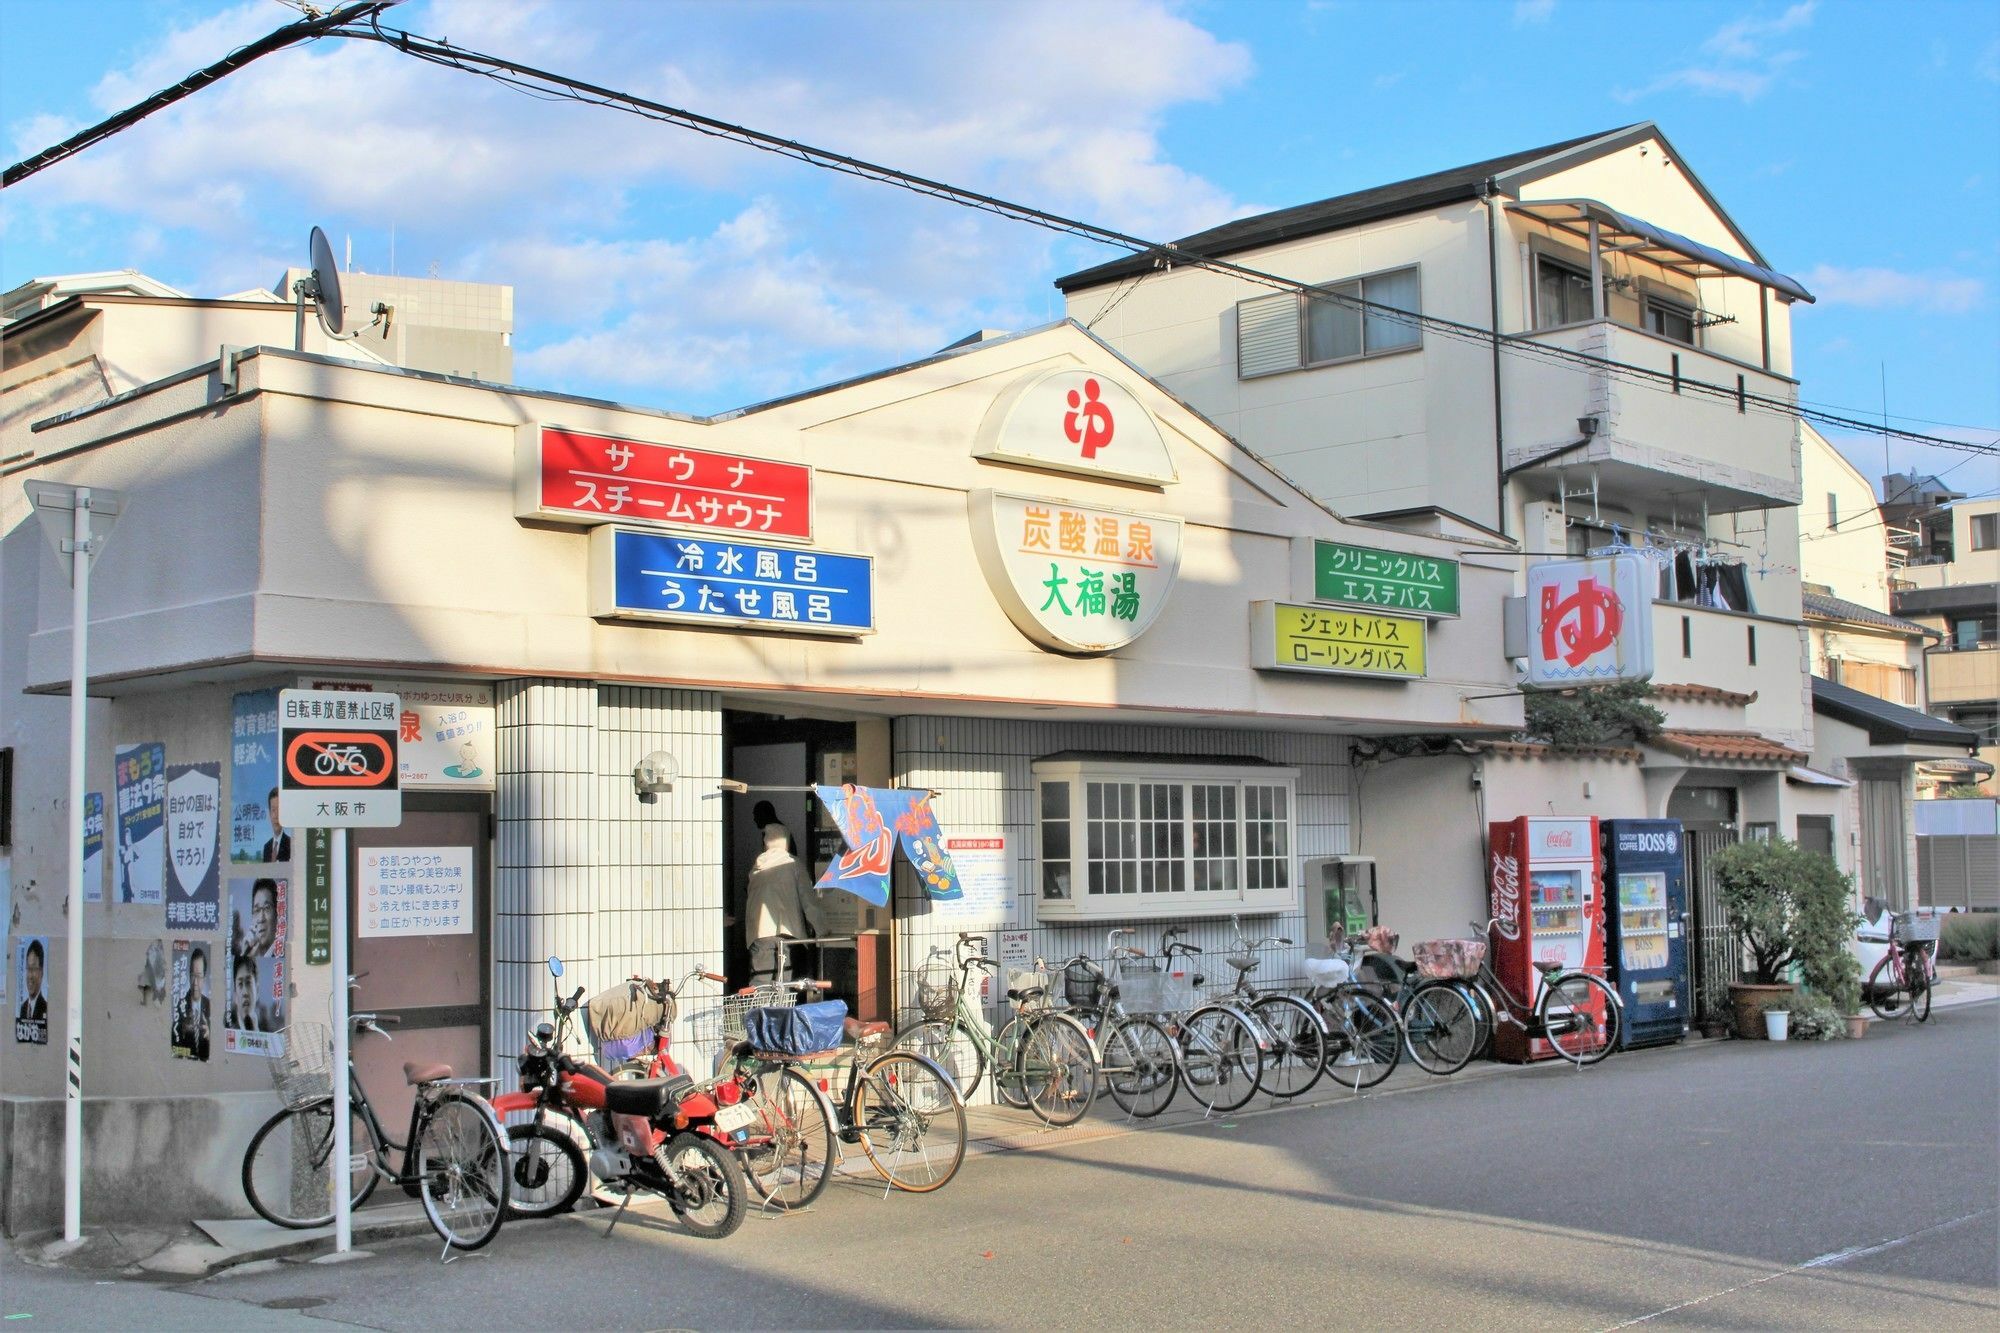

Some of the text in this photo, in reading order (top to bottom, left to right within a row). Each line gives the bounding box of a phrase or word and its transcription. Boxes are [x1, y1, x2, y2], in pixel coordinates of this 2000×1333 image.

[1063, 378, 1115, 460] ゆ
[604, 443, 754, 488] サウナ
[572, 480, 783, 531] スチームサウナ
[1022, 505, 1154, 561] 炭酸温泉
[675, 542, 818, 583] 冷水風呂
[1332, 548, 1441, 582] クリニックバス
[661, 580, 832, 623] うたせ風呂
[1040, 562, 1141, 622] 大福湯
[1343, 581, 1433, 610] エステバス
[1300, 612, 1400, 640] ジェットバス
[1541, 576, 1623, 669] ゆ
[1293, 643, 1407, 670] ローリングバス
[286, 699, 395, 721] 自転車放置禁止区域
[439, 711, 467, 726] 入浴の
[118, 746, 164, 786] まもろう
[119, 774, 165, 815] 憲法9条
[169, 794, 217, 815] 自分の国は、
[316, 801, 367, 816] 大阪市
[178, 821, 204, 840] 自分で
[1619, 842, 1638, 851] COFFEE
[1638, 833, 1666, 852] BOSS
[176, 848, 206, 868] 守ろう!
[379, 855, 442, 867] お肌つやつや
[380, 867, 462, 880] 若さを保つ美容効果
[168, 902, 217, 924] 幸福実現党
[313, 898, 328, 912] 14
[380, 900, 461, 912] 冷え性にききます
[380, 916, 461, 929] 血圧が下がります
[1635, 936, 1654, 952] BOSS
